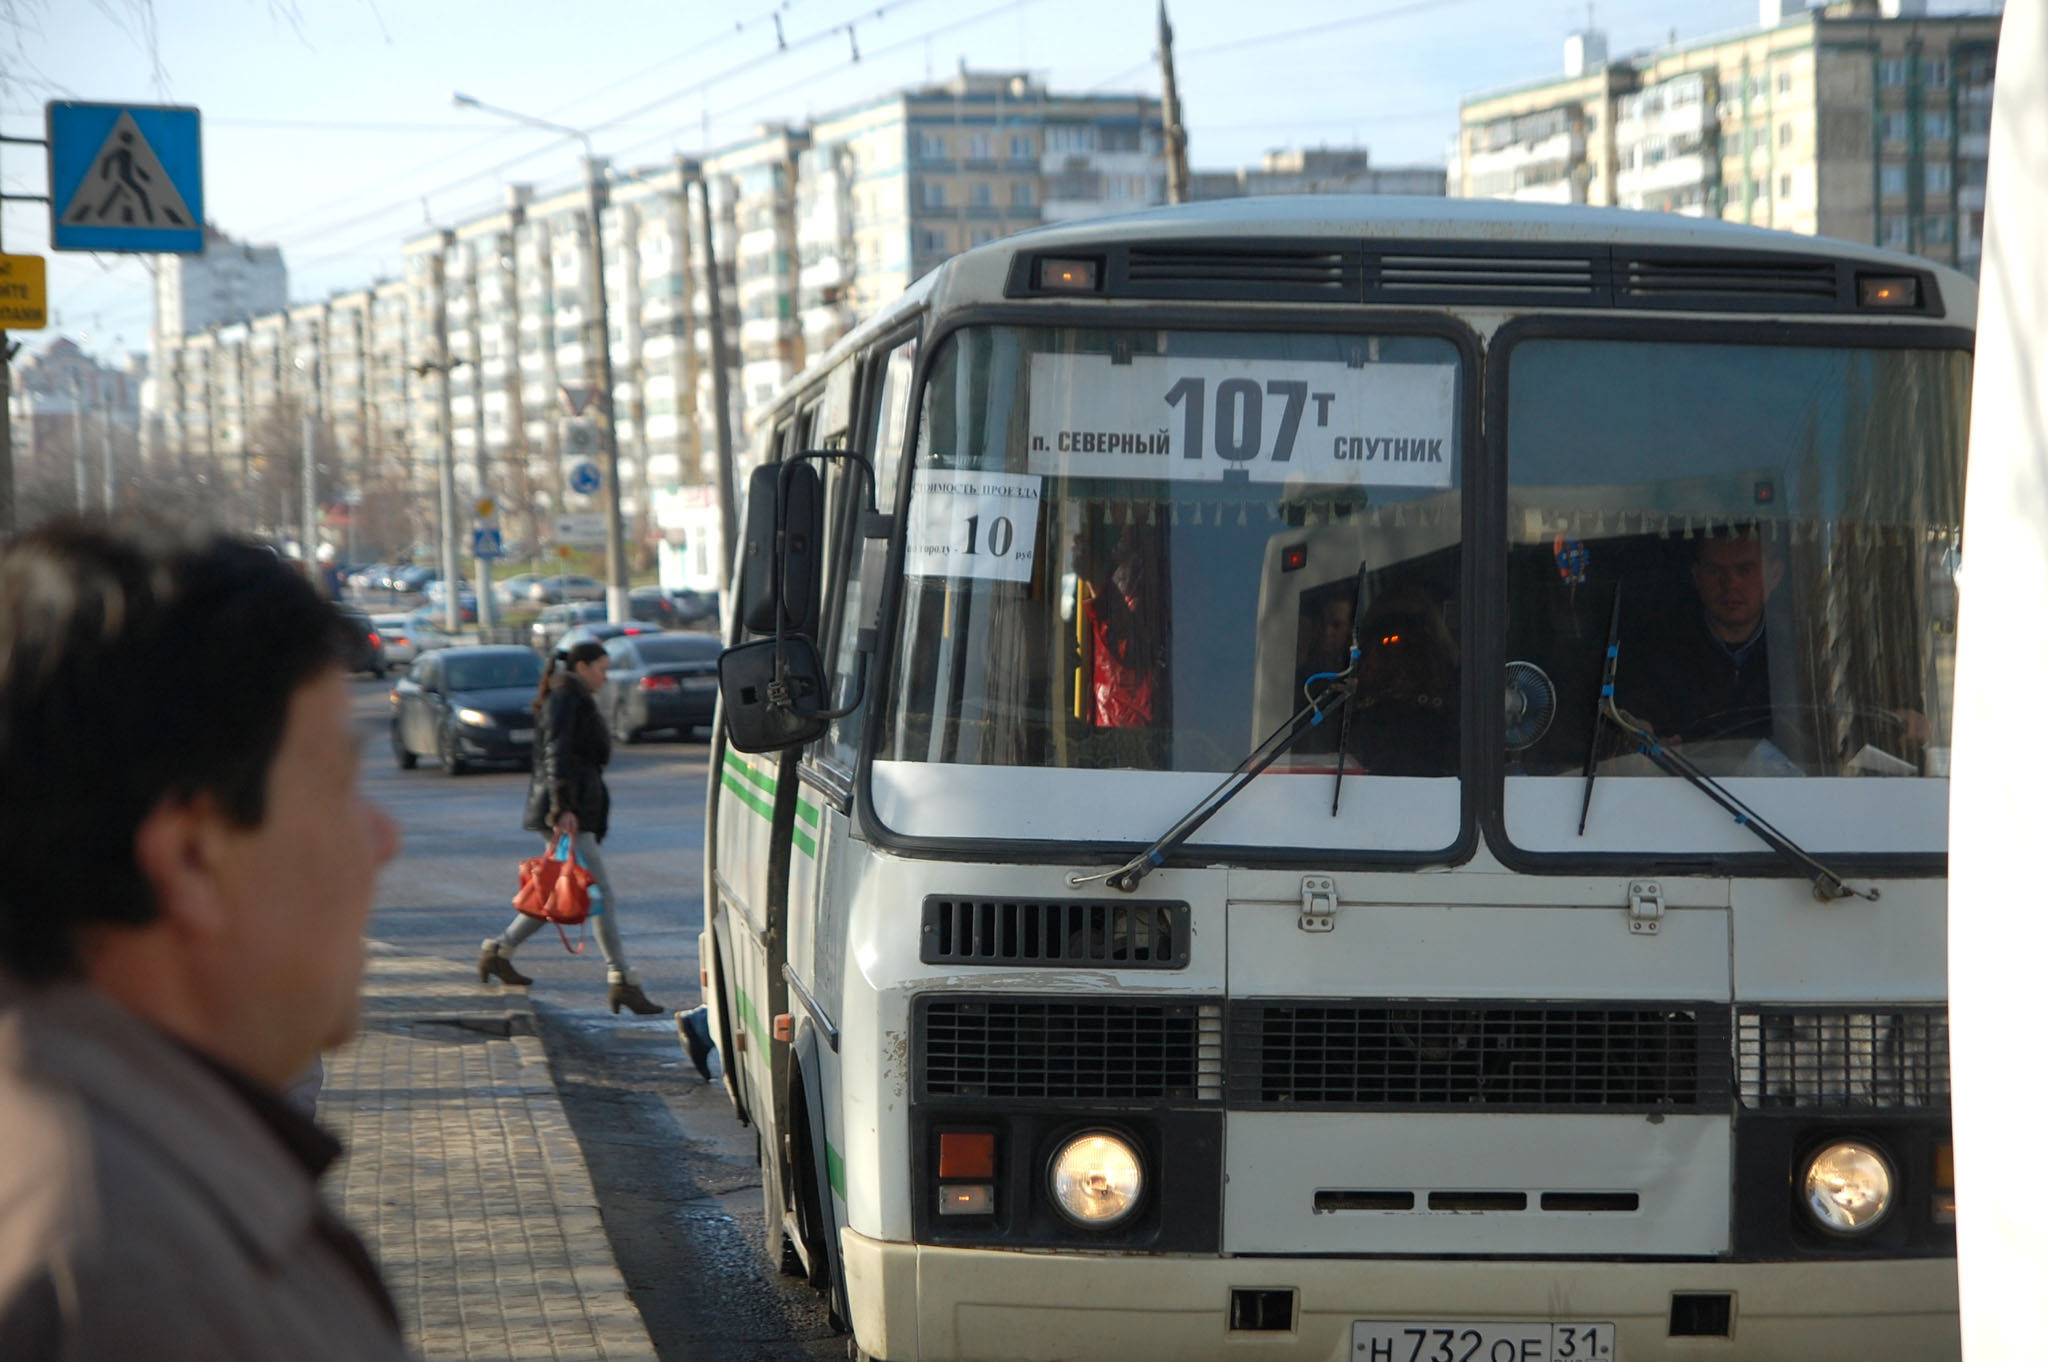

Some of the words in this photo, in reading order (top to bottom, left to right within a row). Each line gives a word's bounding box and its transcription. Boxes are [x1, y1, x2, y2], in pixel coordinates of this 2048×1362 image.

[1058, 428, 1170, 455] СЕВЕРНЫЙ
[1333, 436, 1443, 463] СПУТНИК
[983, 485, 1038, 498] ПРОЕЗДА
[962, 513, 1014, 557] 10
[1557, 1327, 1597, 1358] 31
